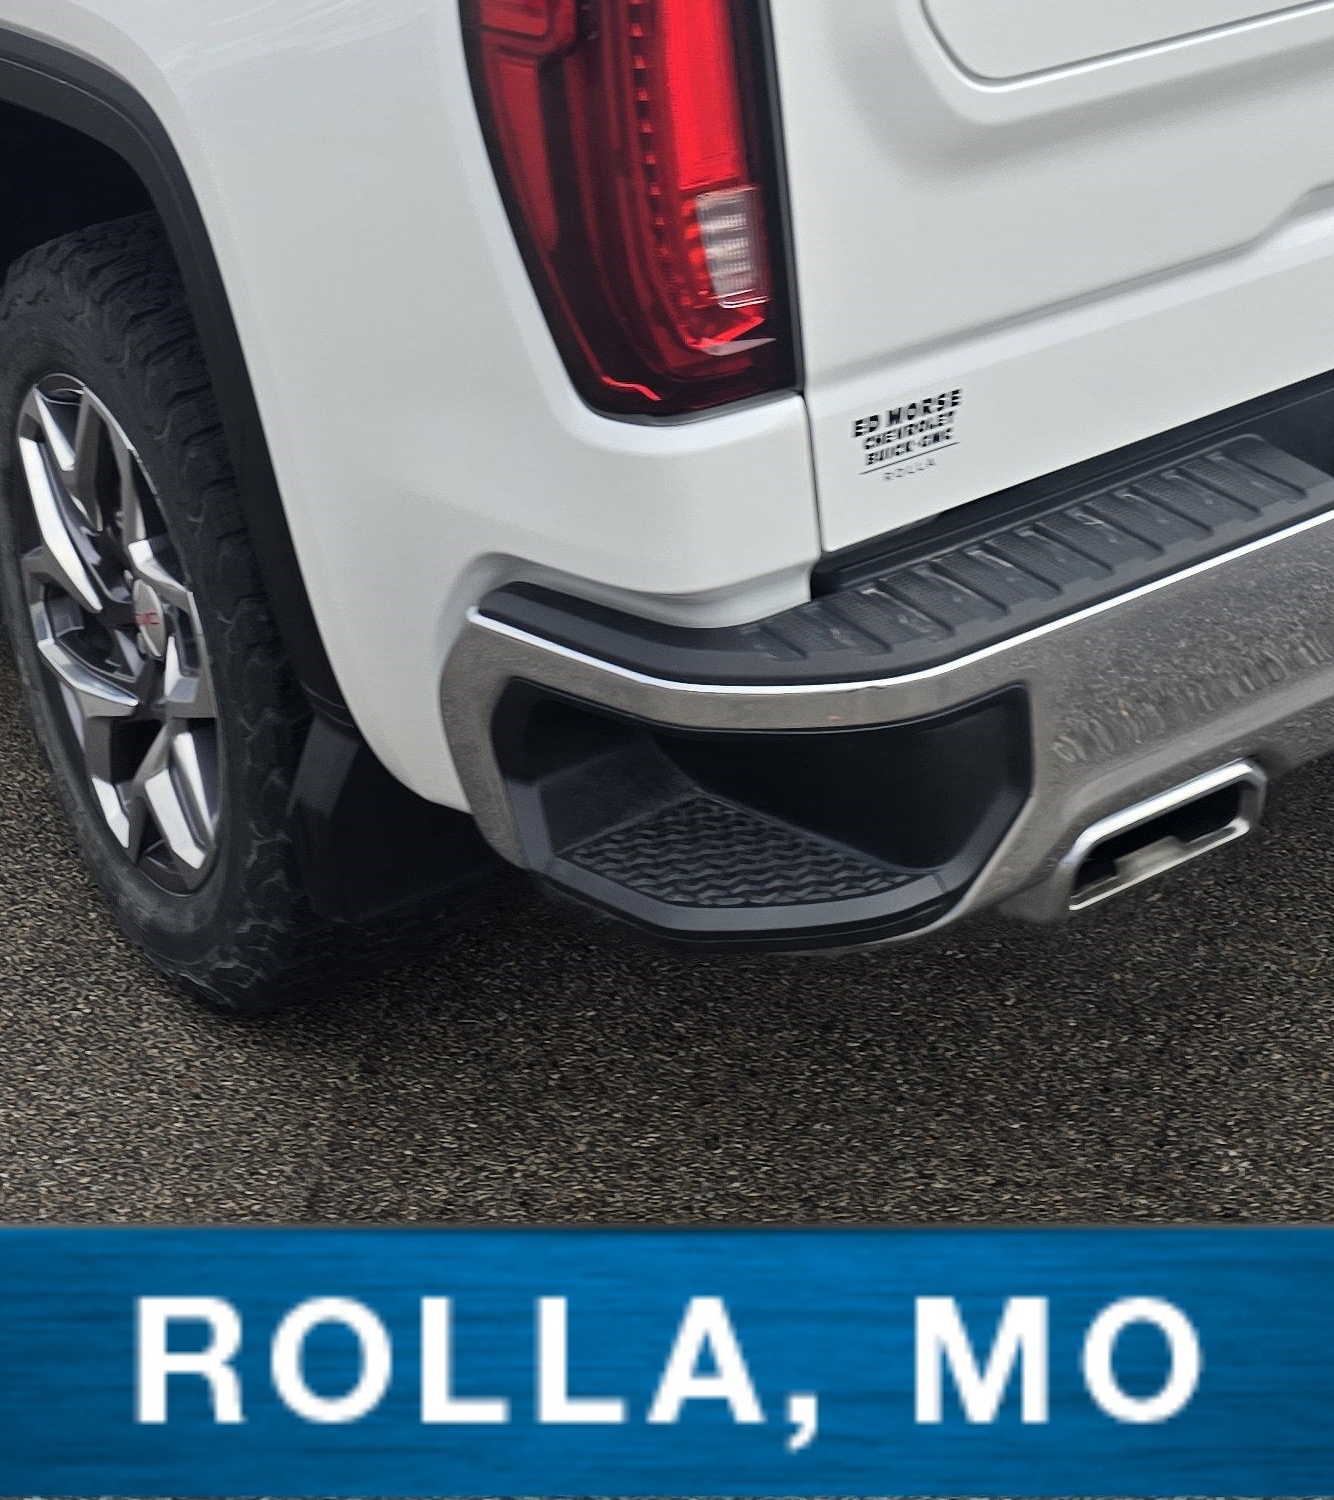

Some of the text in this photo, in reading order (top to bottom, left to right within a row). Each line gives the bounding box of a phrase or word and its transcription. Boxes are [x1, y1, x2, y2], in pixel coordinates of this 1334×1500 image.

[853, 388, 961, 438] ED MORSE
[865, 411, 955, 450] CHEVROLET
